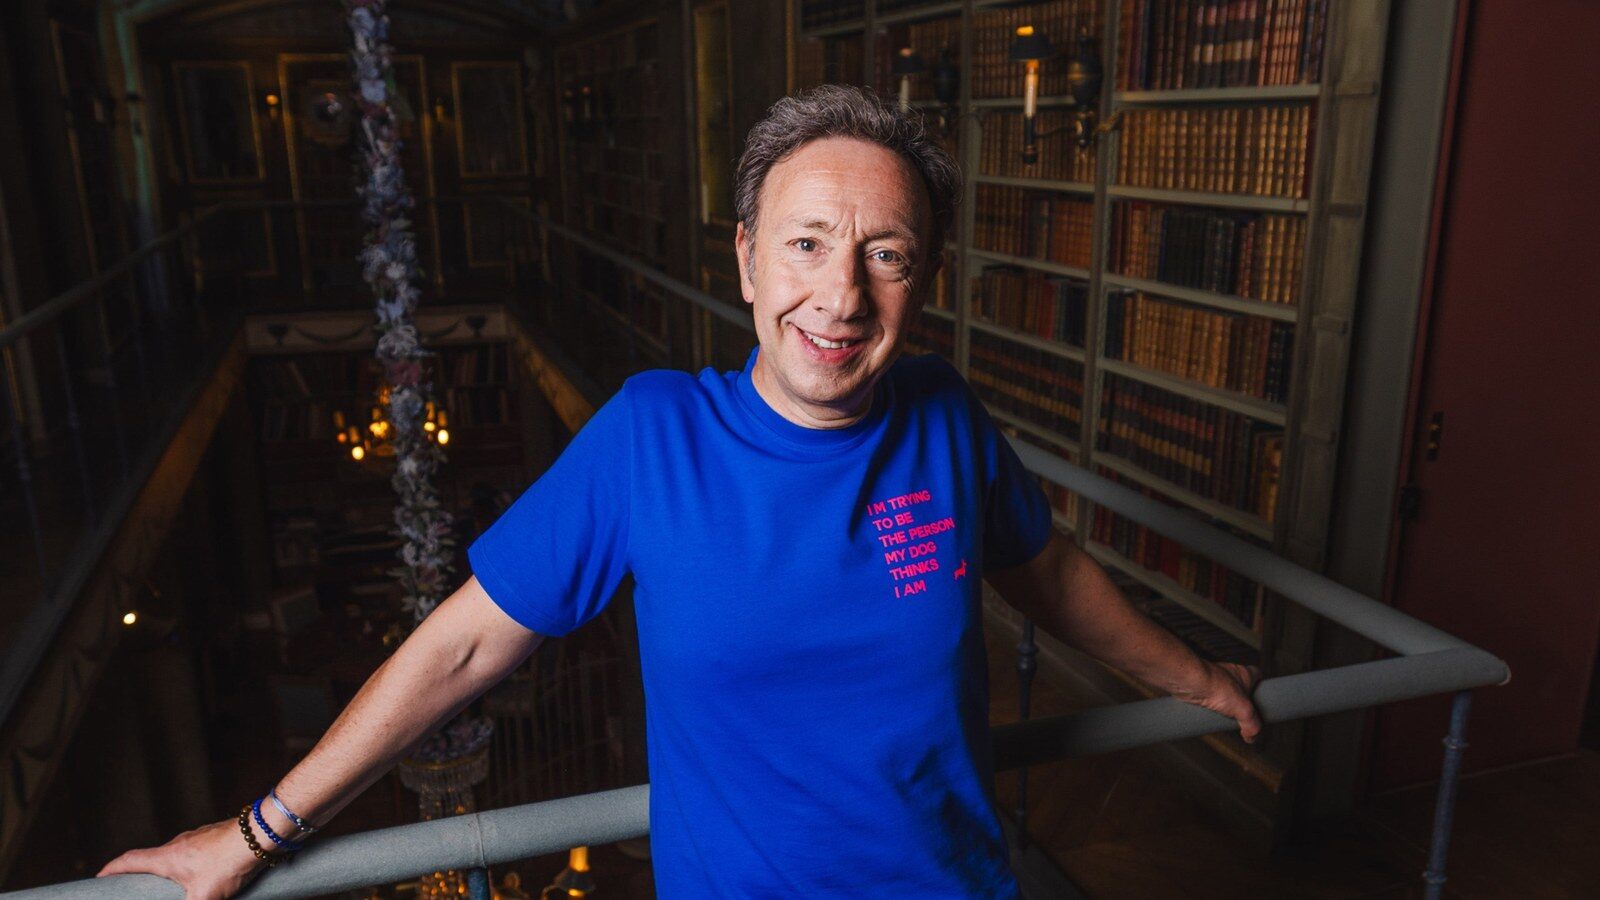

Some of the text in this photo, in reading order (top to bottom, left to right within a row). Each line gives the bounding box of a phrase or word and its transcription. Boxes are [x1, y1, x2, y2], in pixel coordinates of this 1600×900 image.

[888, 490, 931, 510] TRYING
[873, 511, 914, 531] TO BE
[879, 517, 955, 547] THE PERSON
[885, 541, 937, 565] MY DOG
[890, 558, 939, 580] THINKS
[895, 580, 926, 599] I AM
